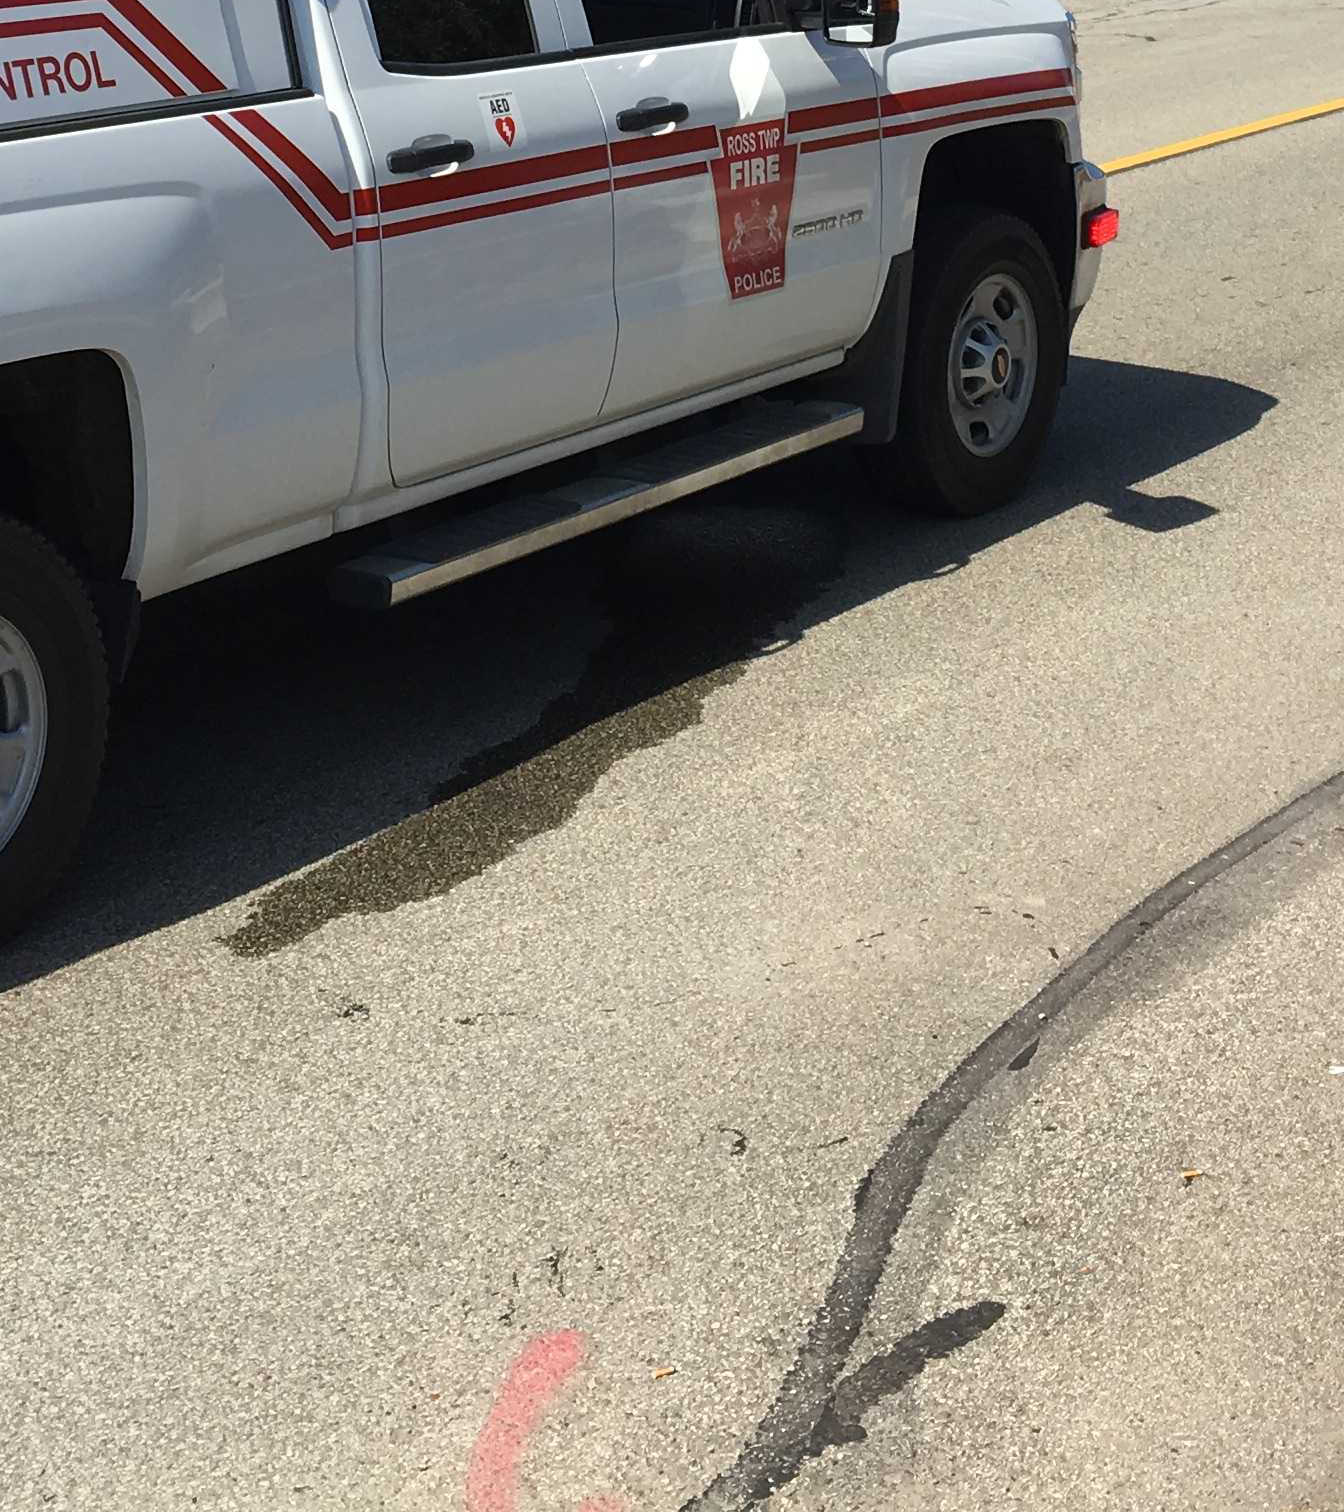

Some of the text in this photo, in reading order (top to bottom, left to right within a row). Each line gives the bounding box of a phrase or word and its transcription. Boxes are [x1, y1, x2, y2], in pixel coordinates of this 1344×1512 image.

[489, 98, 511, 115] AED
[727, 132, 757, 157] ROSS
[729, 153, 781, 191] FIRE
[734, 266, 783, 293] POLICE
